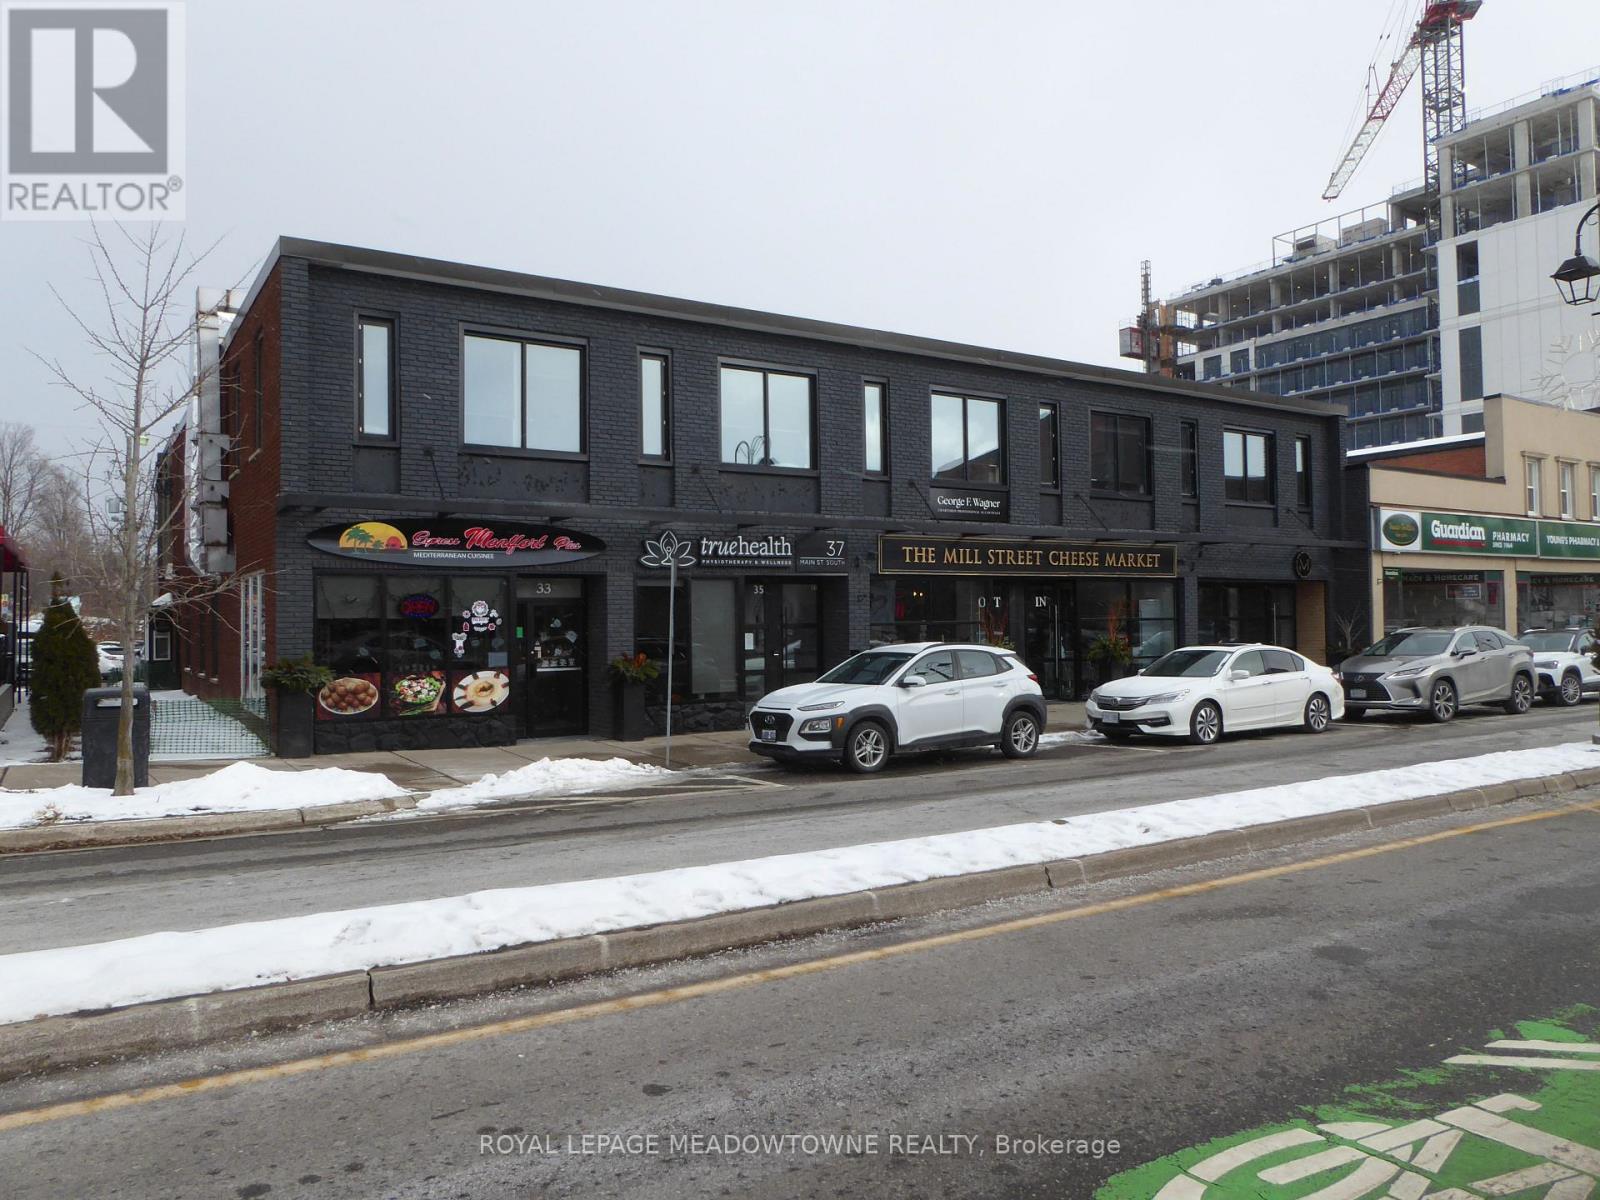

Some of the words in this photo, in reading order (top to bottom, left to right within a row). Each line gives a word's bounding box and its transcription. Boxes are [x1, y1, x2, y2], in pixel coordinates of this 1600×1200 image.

[937, 495, 965, 509] George
[966, 497, 972, 507] F.
[973, 498, 1001, 510] Wagner
[1431, 520, 1485, 540] Guardian
[412, 530, 461, 547] Express
[553, 535, 582, 551] Plus
[1492, 531, 1529, 543] PHARMACY
[1546, 535, 1568, 545] YOUNG'S
[1569, 537, 1596, 547] PHARMACY
[701, 535, 793, 556] truehealth
[826, 541, 845, 557] 37
[413, 551, 467, 560] MEDITERRANEAN
[902, 546, 936, 564] THE
[943, 548, 982, 565] MILL
[988, 549, 1043, 566] STREET
[1049, 551, 1099, 567] CHEESE
[1105, 553, 1161, 568] MARKET
[536, 583, 552, 594] 33
[753, 585, 765, 595] 35
[1035, 596, 1048, 608] IN
